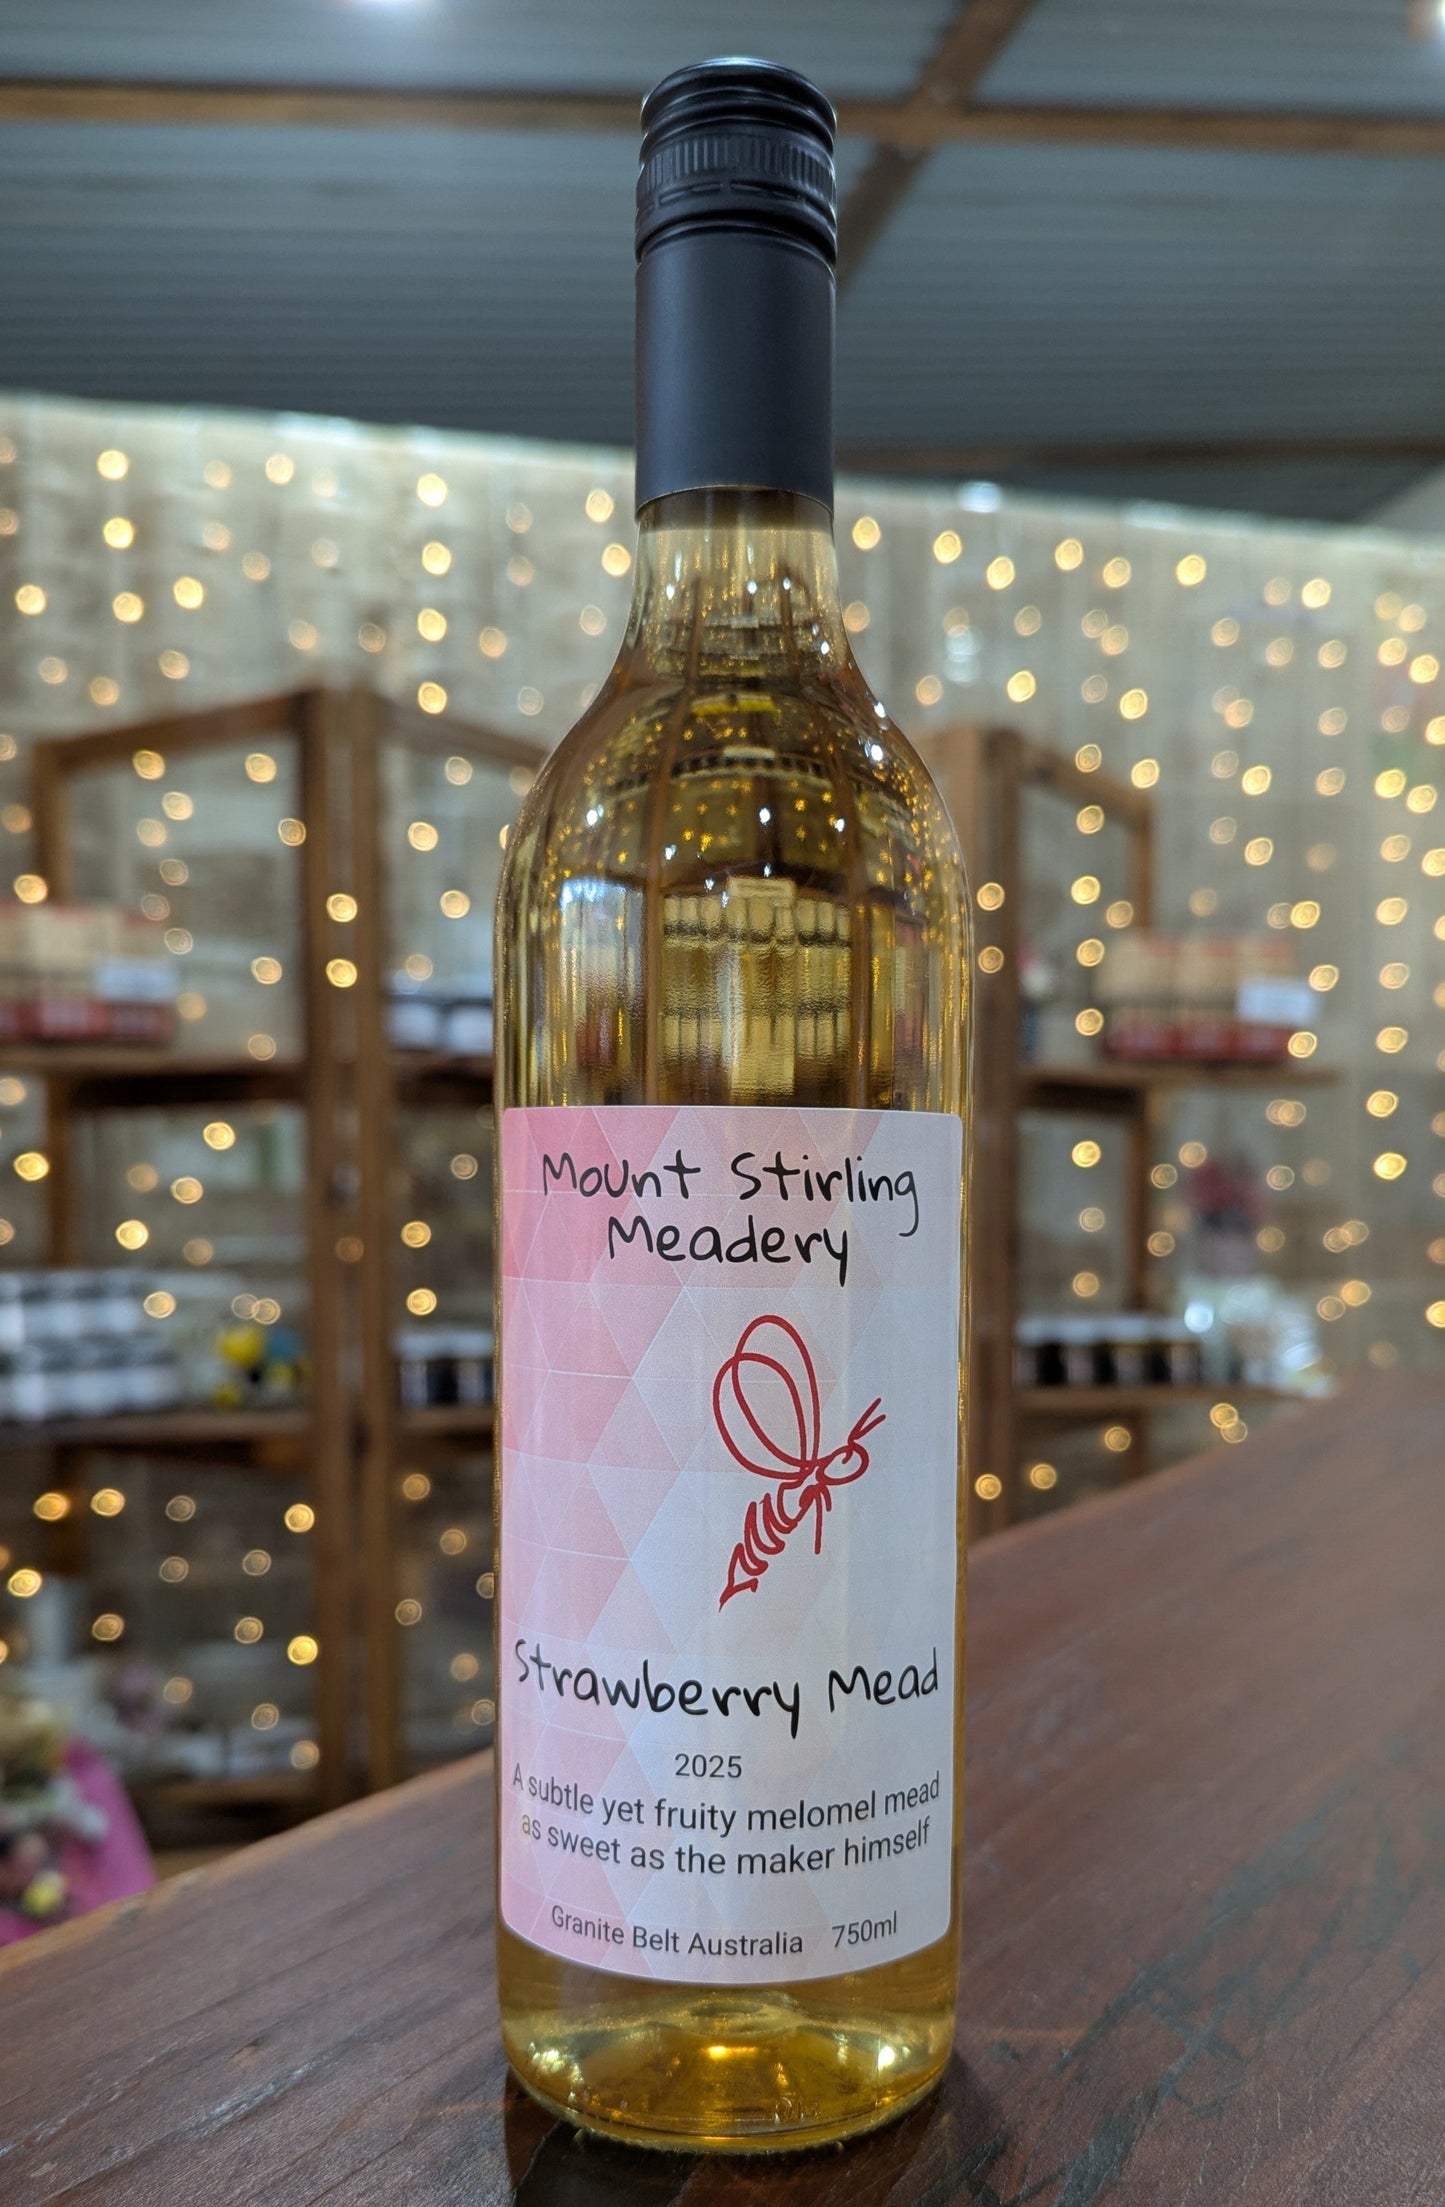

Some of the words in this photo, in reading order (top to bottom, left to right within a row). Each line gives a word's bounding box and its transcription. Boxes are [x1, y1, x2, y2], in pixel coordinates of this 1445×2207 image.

[542, 1149, 701, 1199] Mount
[731, 1151, 919, 1237] Stirling
[607, 1214, 848, 1287] Meadery
[514, 1639, 800, 1739] Strawberry
[828, 1647, 938, 1712] Mead
[512, 1763, 525, 1790] A
[528, 1775, 594, 1815] subtle
[601, 1796, 644, 1826] yet
[654, 1798, 736, 1838] fruity
[747, 1791, 876, 1831] melomel
[884, 1770, 940, 1816] mead
[674, 1753, 743, 1778] 2025
[521, 1812, 542, 1841] as
[547, 1826, 621, 1865] sweet
[630, 1845, 665, 1871] as
[675, 1845, 726, 1875] the
[736, 1845, 836, 1875] maker
[843, 1816, 931, 1866] himself
[551, 1904, 625, 1944] Granite
[632, 1925, 680, 1954] Belt
[687, 1931, 804, 1957] Australia
[831, 1911, 897, 1949] 750ml
